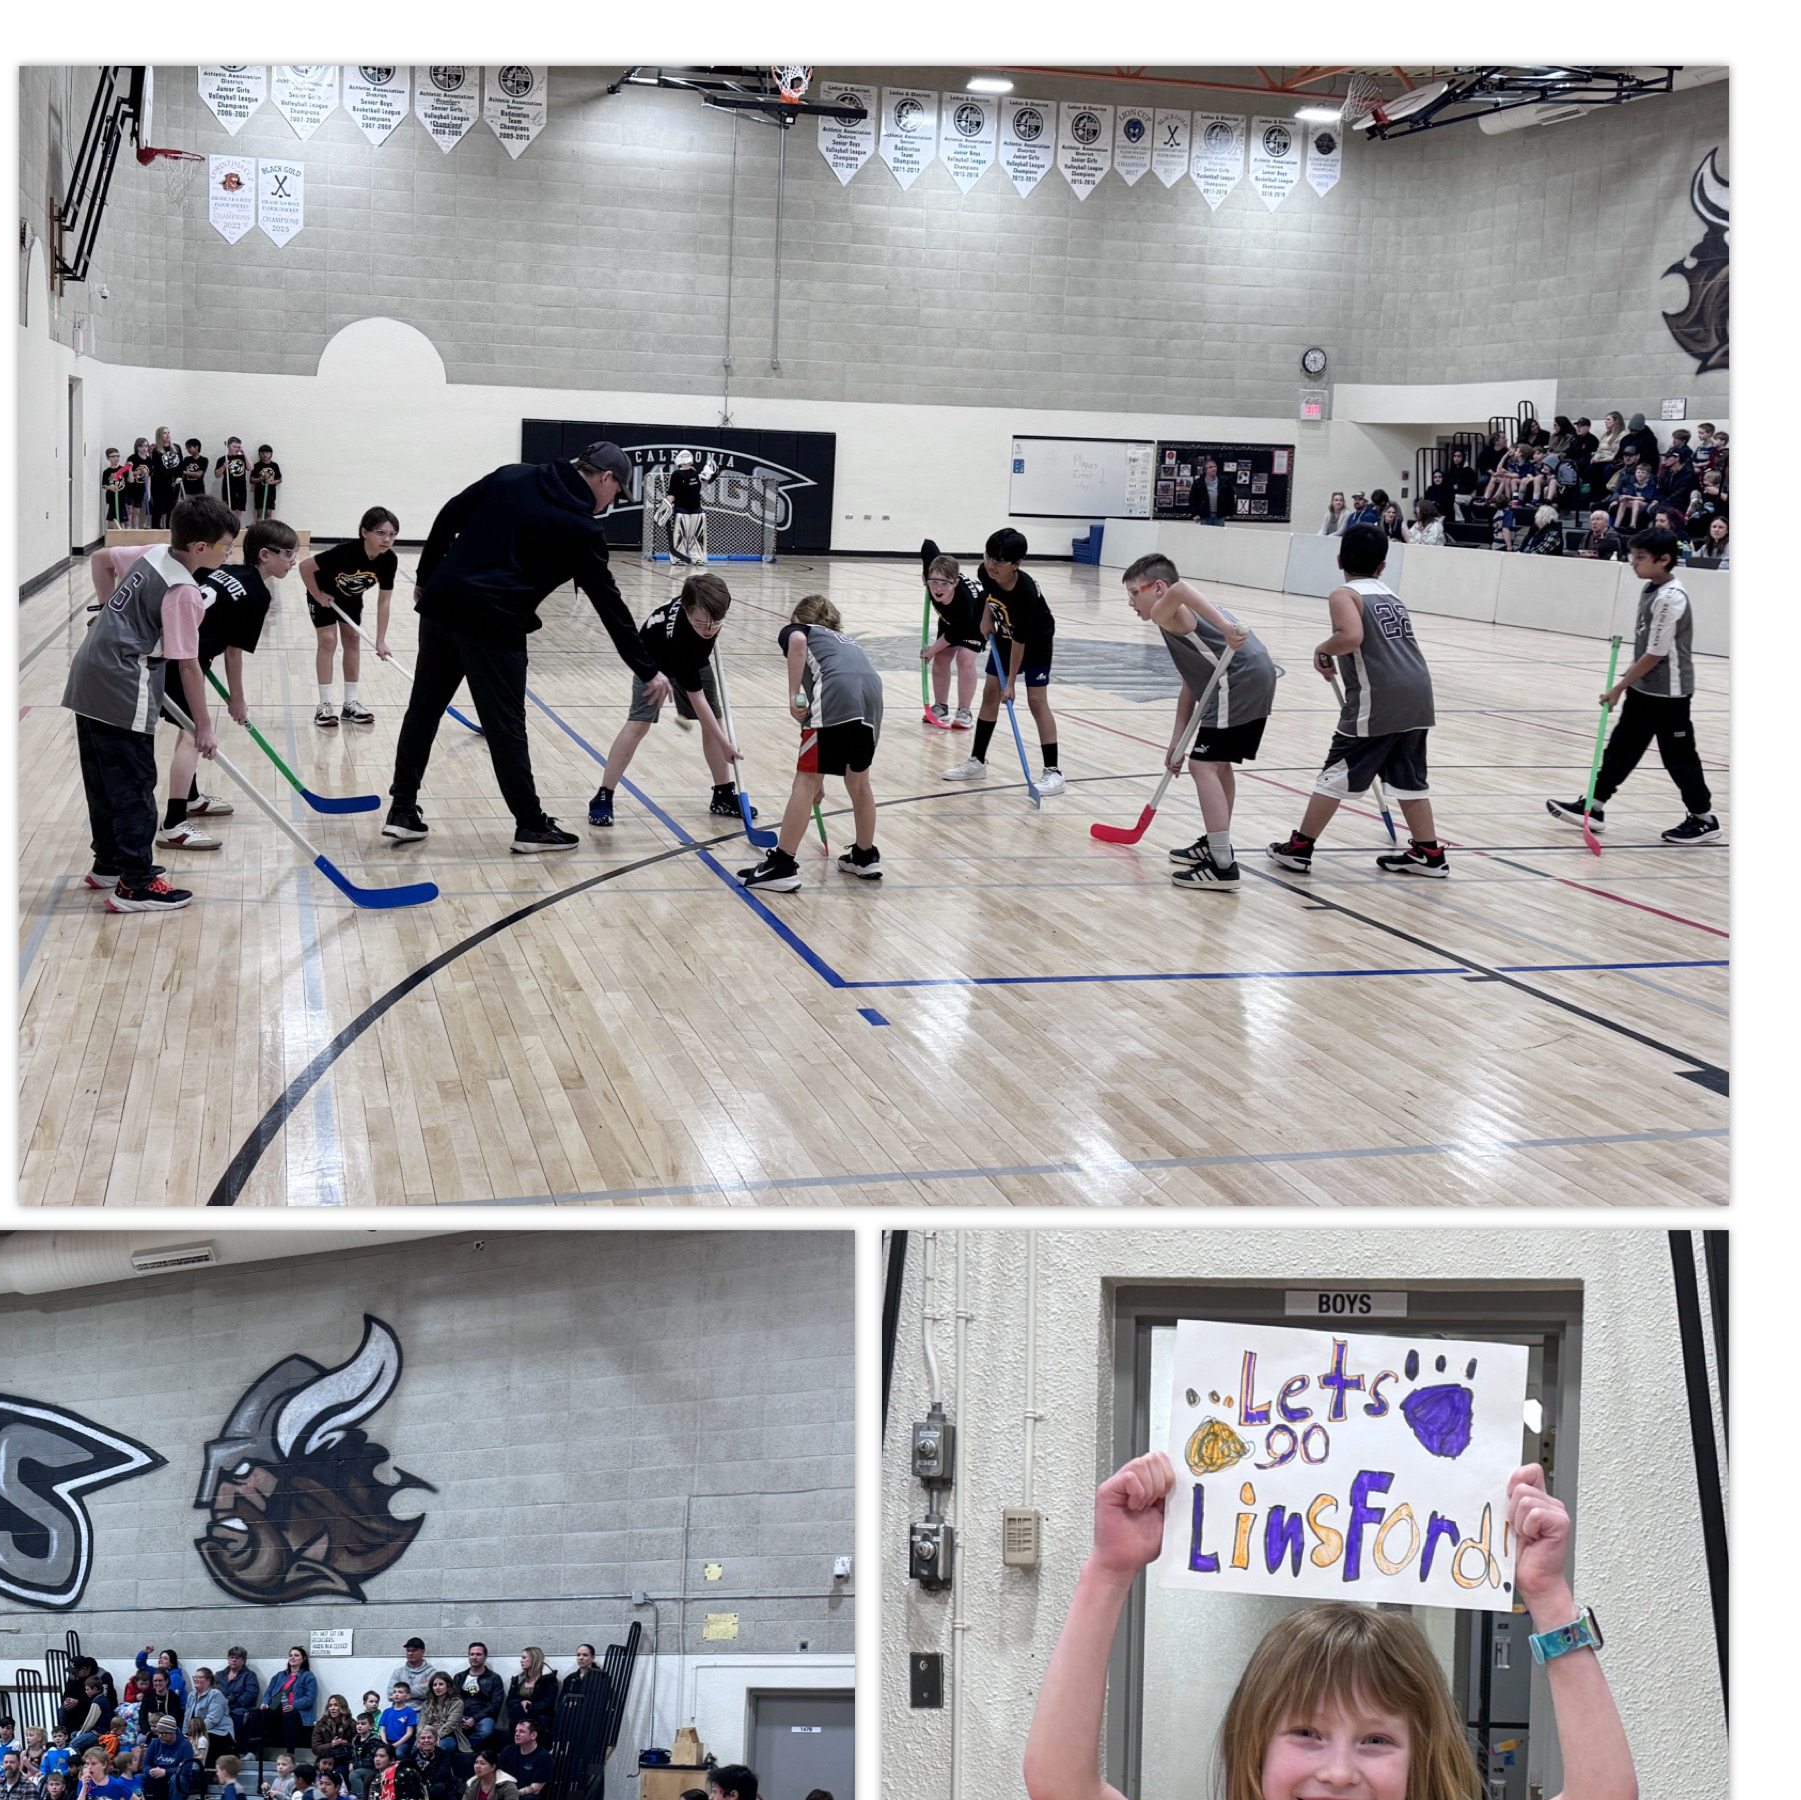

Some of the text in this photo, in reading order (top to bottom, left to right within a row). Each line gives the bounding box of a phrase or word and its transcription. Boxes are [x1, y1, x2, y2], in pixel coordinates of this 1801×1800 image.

[261, 165, 282, 175] BLACK
[283, 166, 302, 177] GOLD
[108, 572, 144, 612] 6
[1318, 1294, 1372, 1314] BOYS
[1238, 1337, 1399, 1426] Lets
